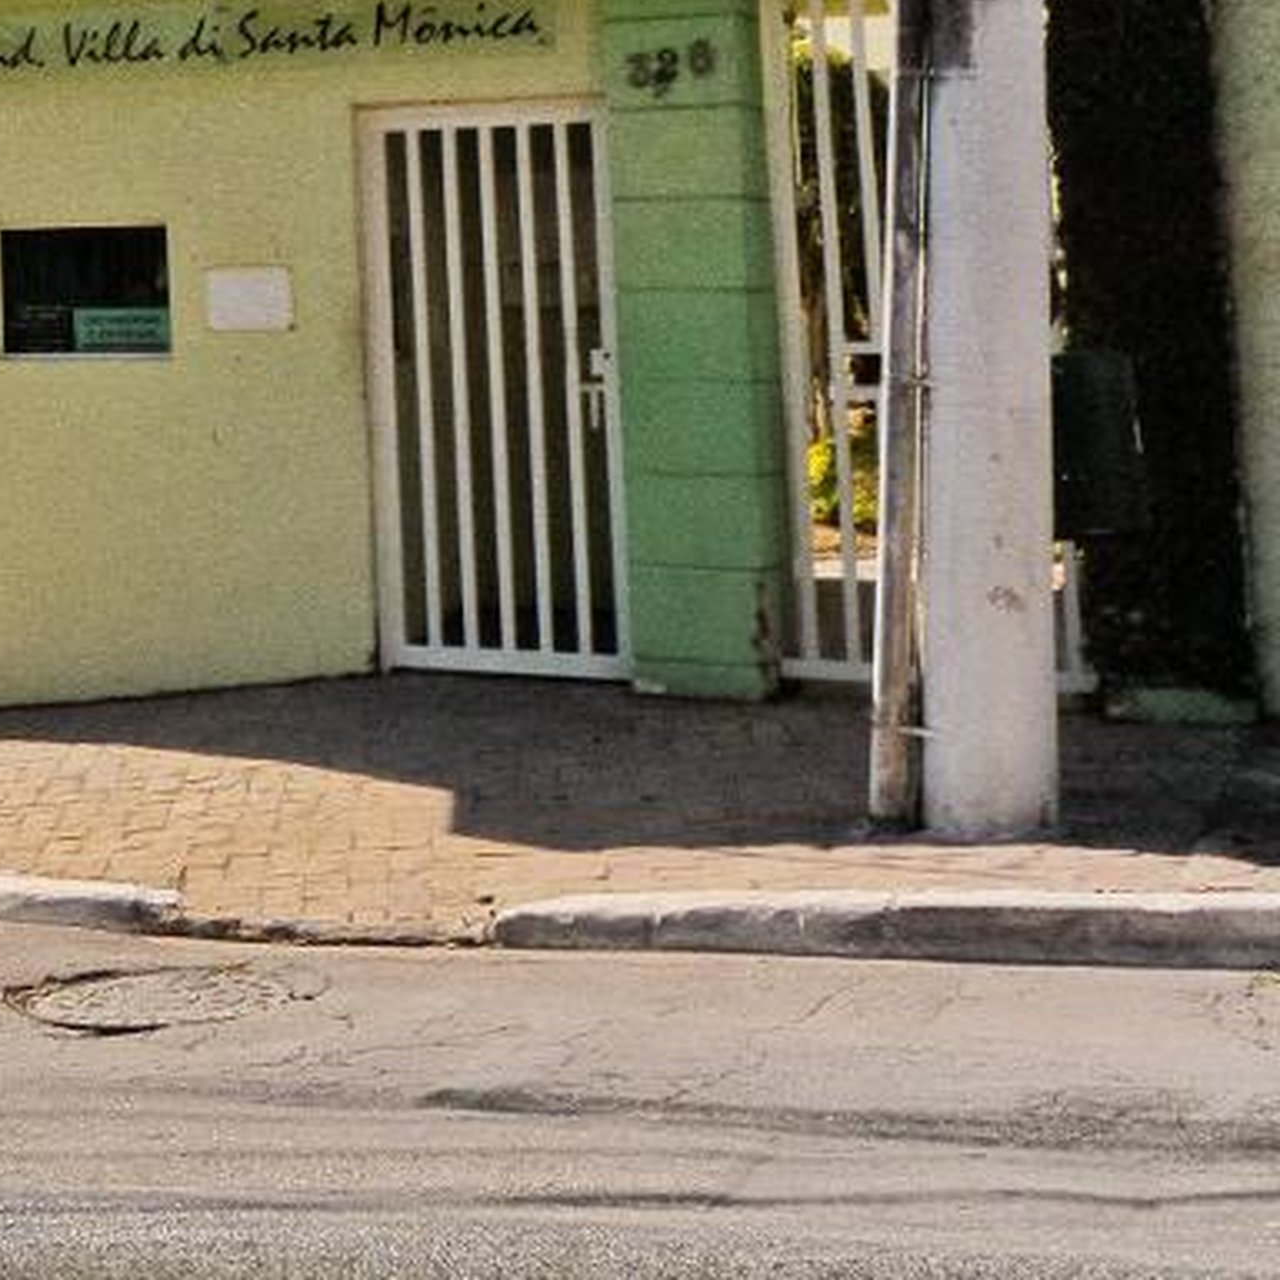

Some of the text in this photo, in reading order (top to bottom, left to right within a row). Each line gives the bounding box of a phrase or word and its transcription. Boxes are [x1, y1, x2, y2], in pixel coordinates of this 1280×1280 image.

[63, 22, 165, 66] Villa
[178, 17, 222, 60] di
[238, 9, 358, 58] Santa
